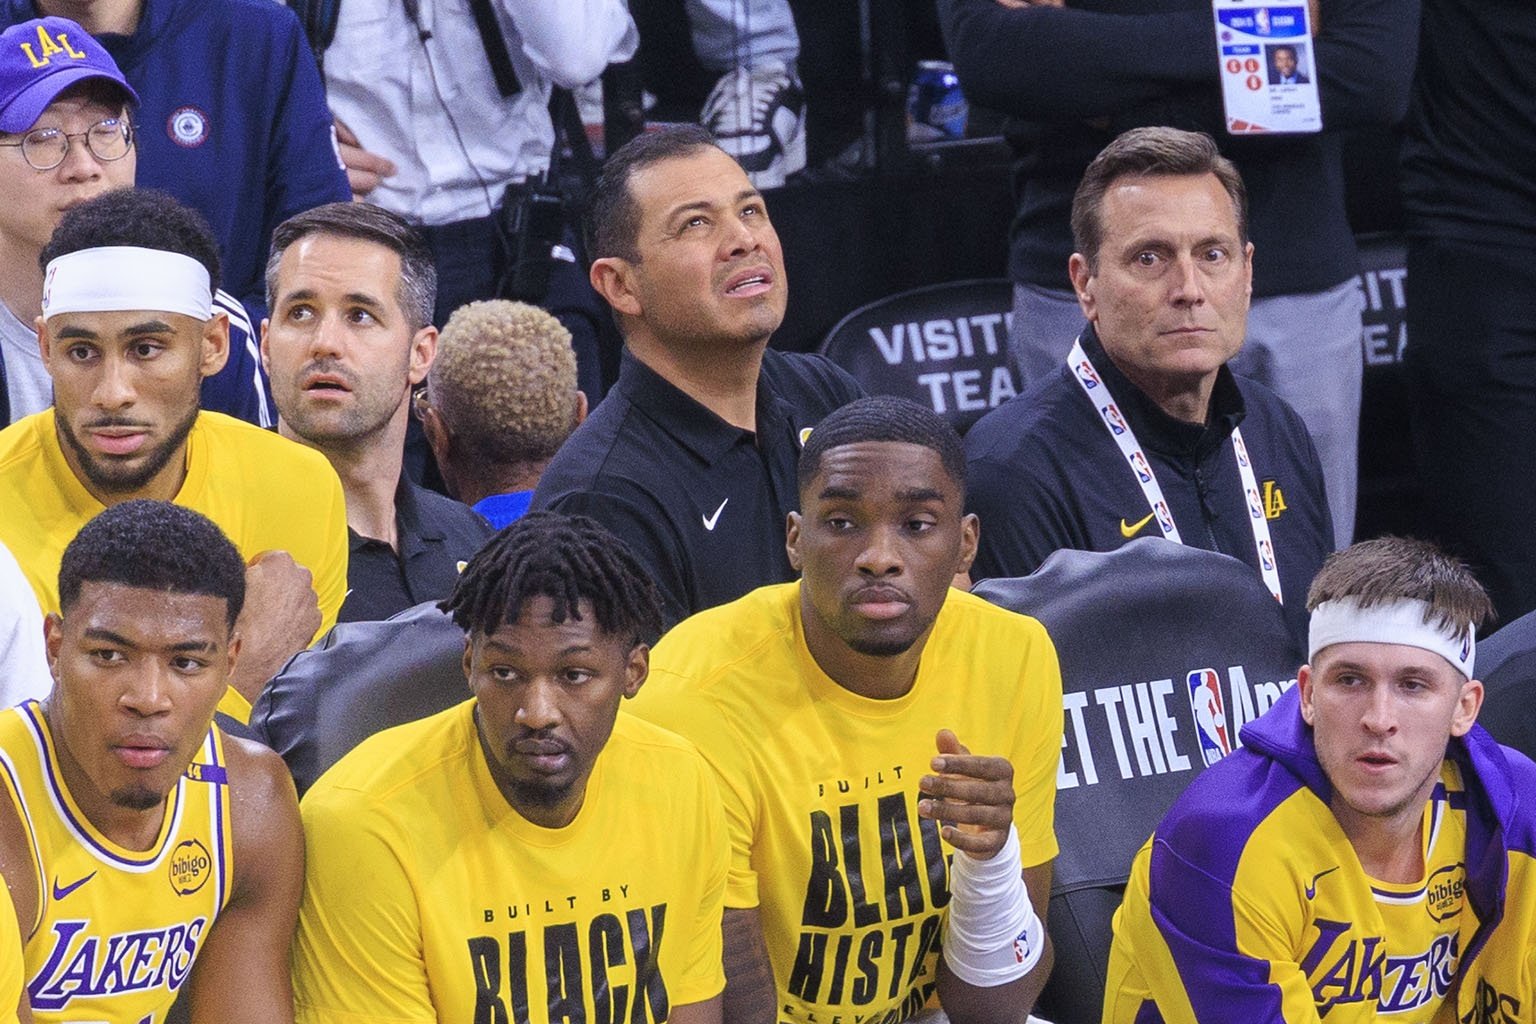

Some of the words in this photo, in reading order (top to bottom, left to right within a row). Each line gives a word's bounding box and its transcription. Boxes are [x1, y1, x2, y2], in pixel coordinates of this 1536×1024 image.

[20, 25, 86, 69] LAL
[1094, 679, 1192, 780] THE
[172, 854, 207, 877] bibigo
[484, 896, 577, 922] BUILT
[602, 884, 629, 902] BY
[1428, 878, 1464, 905] bibig
[27, 917, 206, 1011] LAKERS
